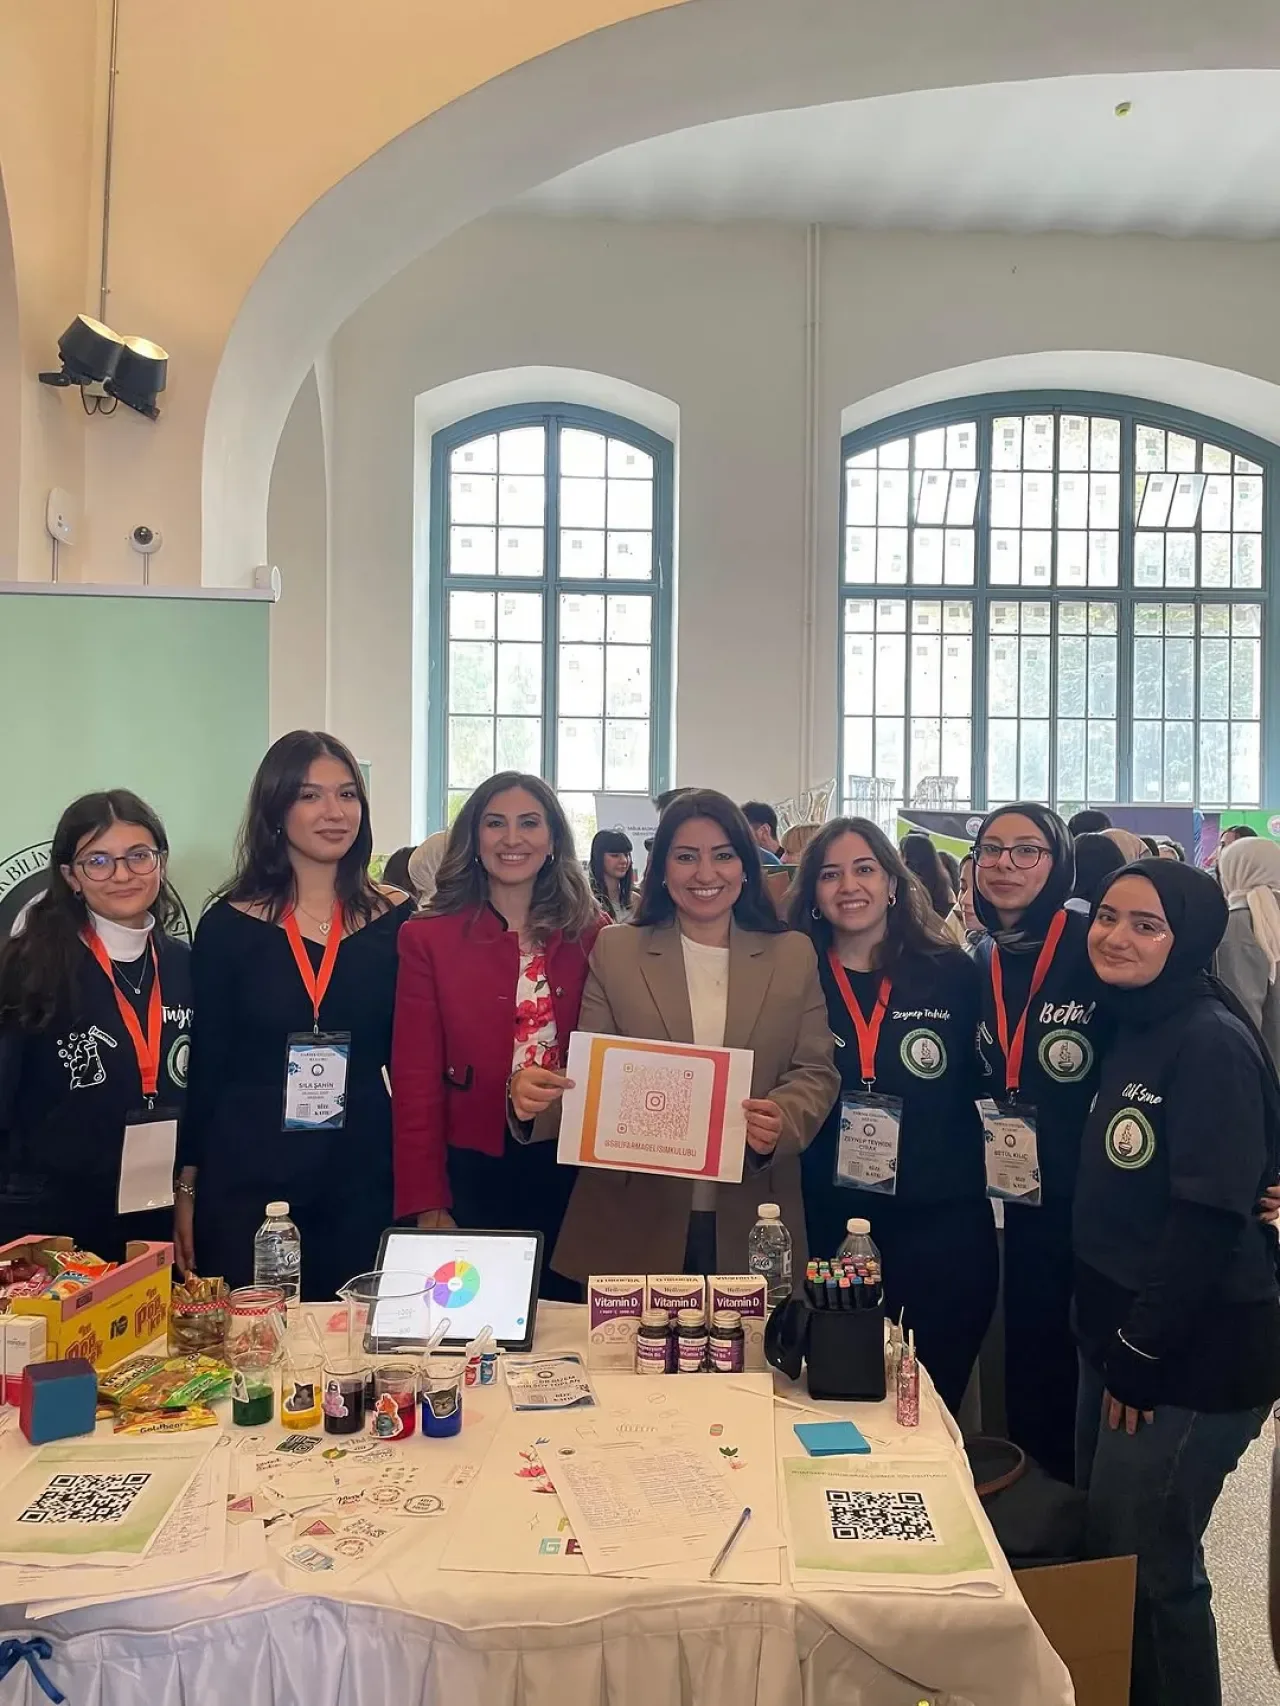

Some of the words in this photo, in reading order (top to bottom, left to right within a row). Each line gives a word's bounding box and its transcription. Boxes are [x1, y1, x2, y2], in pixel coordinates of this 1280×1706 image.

[161, 1004, 194, 1029] Tuğç
[1039, 1000, 1096, 1025] Betül
[594, 1297, 630, 1307] Vitamin
[653, 1297, 689, 1307] Vitamin
[716, 1297, 752, 1307] Vitamin
